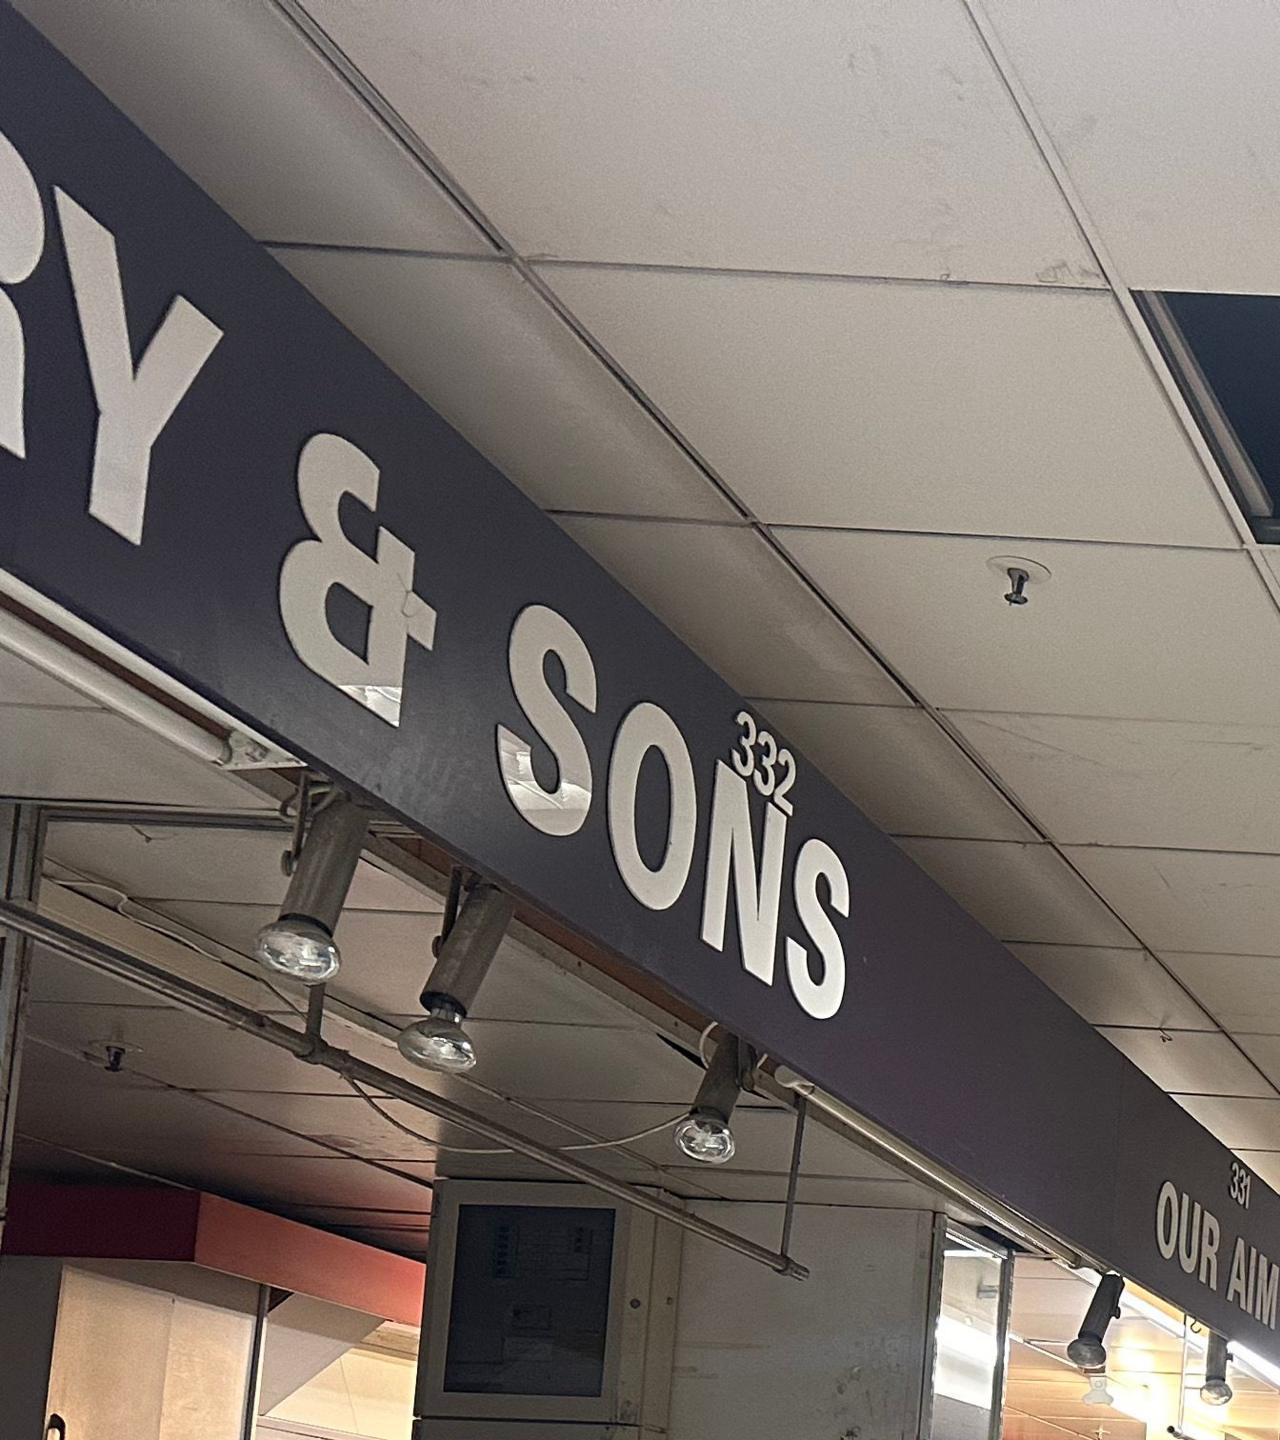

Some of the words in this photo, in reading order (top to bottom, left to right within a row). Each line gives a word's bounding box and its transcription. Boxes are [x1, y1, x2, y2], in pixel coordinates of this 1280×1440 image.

[279, 432, 438, 728] &
[496, 603, 850, 1020] SONS
[731, 711, 796, 817] 332
[1230, 1161, 1251, 1210] 331
[1156, 1181, 1221, 1292] OUR
[1226, 1237, 1280, 1331] AIM
